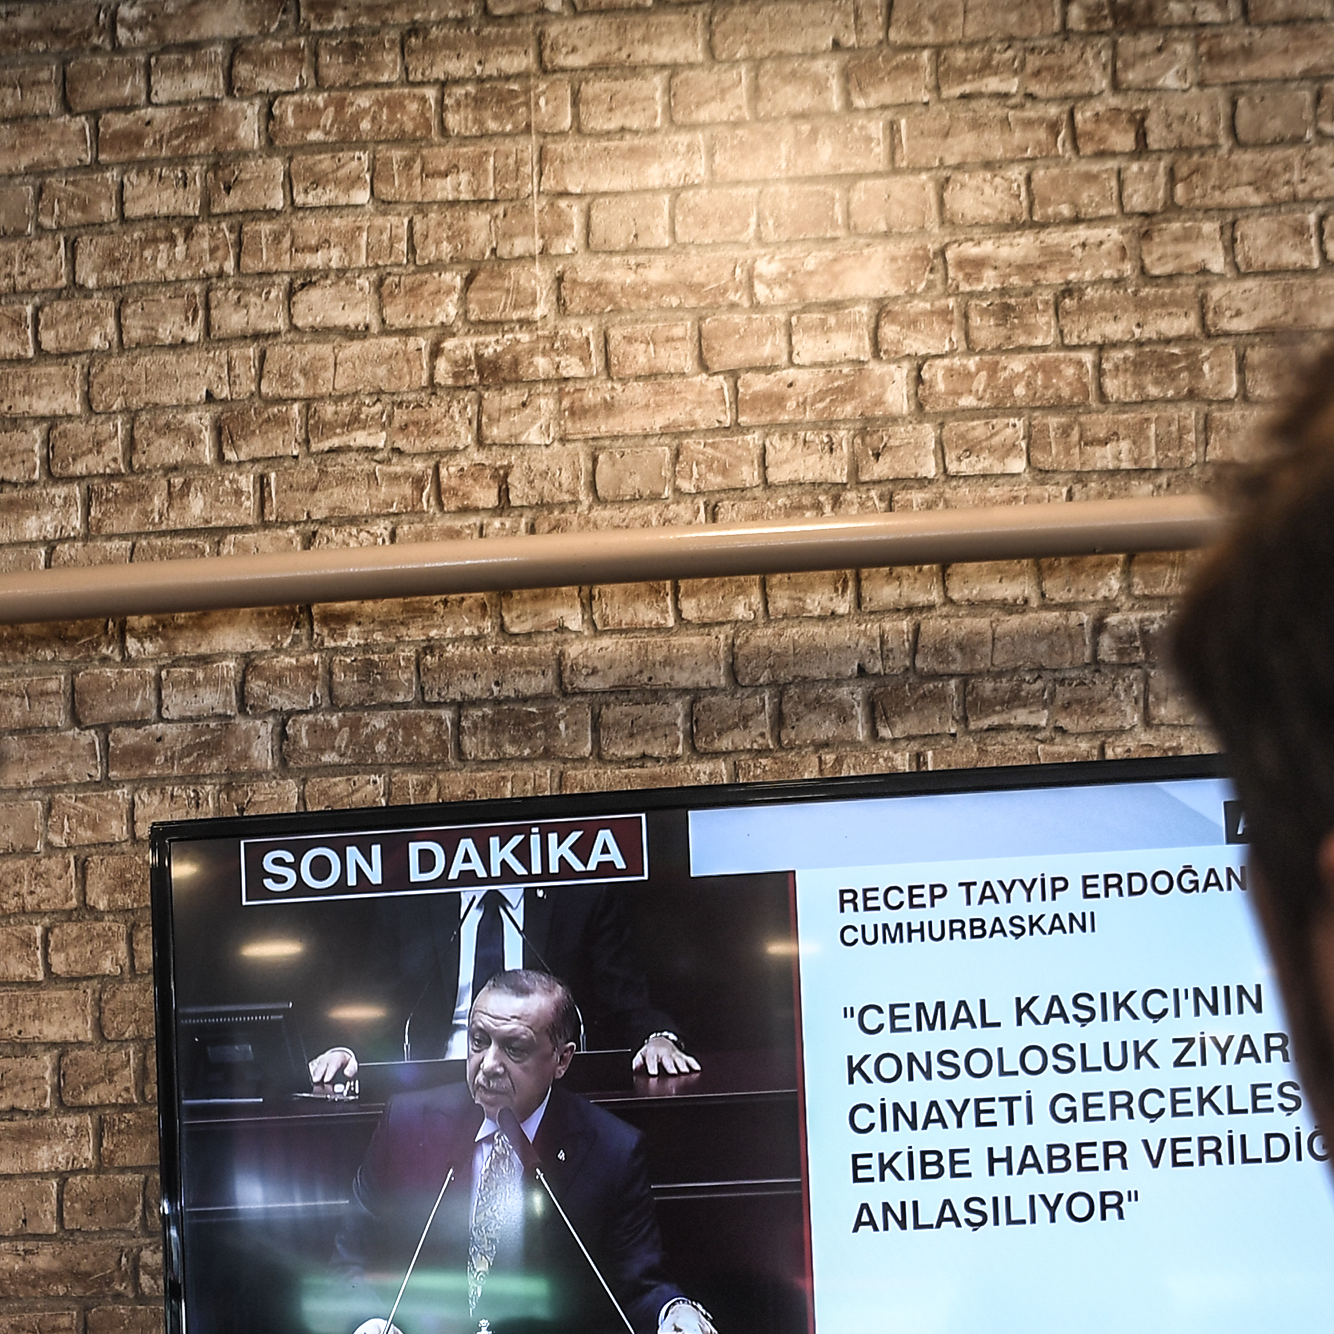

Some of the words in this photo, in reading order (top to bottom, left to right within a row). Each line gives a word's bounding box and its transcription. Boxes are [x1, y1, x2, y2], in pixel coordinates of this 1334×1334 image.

[263, 845, 383, 893] SON
[409, 827, 627, 883] DAKİKA
[839, 883, 948, 914] RECEP
[958, 872, 1069, 907] TAYYİP
[1082, 864, 1248, 899] ERDOĞAN
[839, 911, 1097, 948] CUMHURBAŞKANI
[843, 999, 1001, 1036] "CEMAL
[1015, 983, 1263, 1028] KAŞIKÇI'NIN
[847, 1038, 1161, 1085] KONSOLOSLUK
[1171, 1031, 1298, 1069] ZİYAR
[848, 1089, 1034, 1135] CİNAYETİ
[1049, 1081, 1303, 1124] GERÇEKLEŞ
[851, 1144, 972, 1184] EKİBE
[987, 1136, 1128, 1177] HABER
[852, 1190, 1140, 1232] ANLAŞILIYOR"
